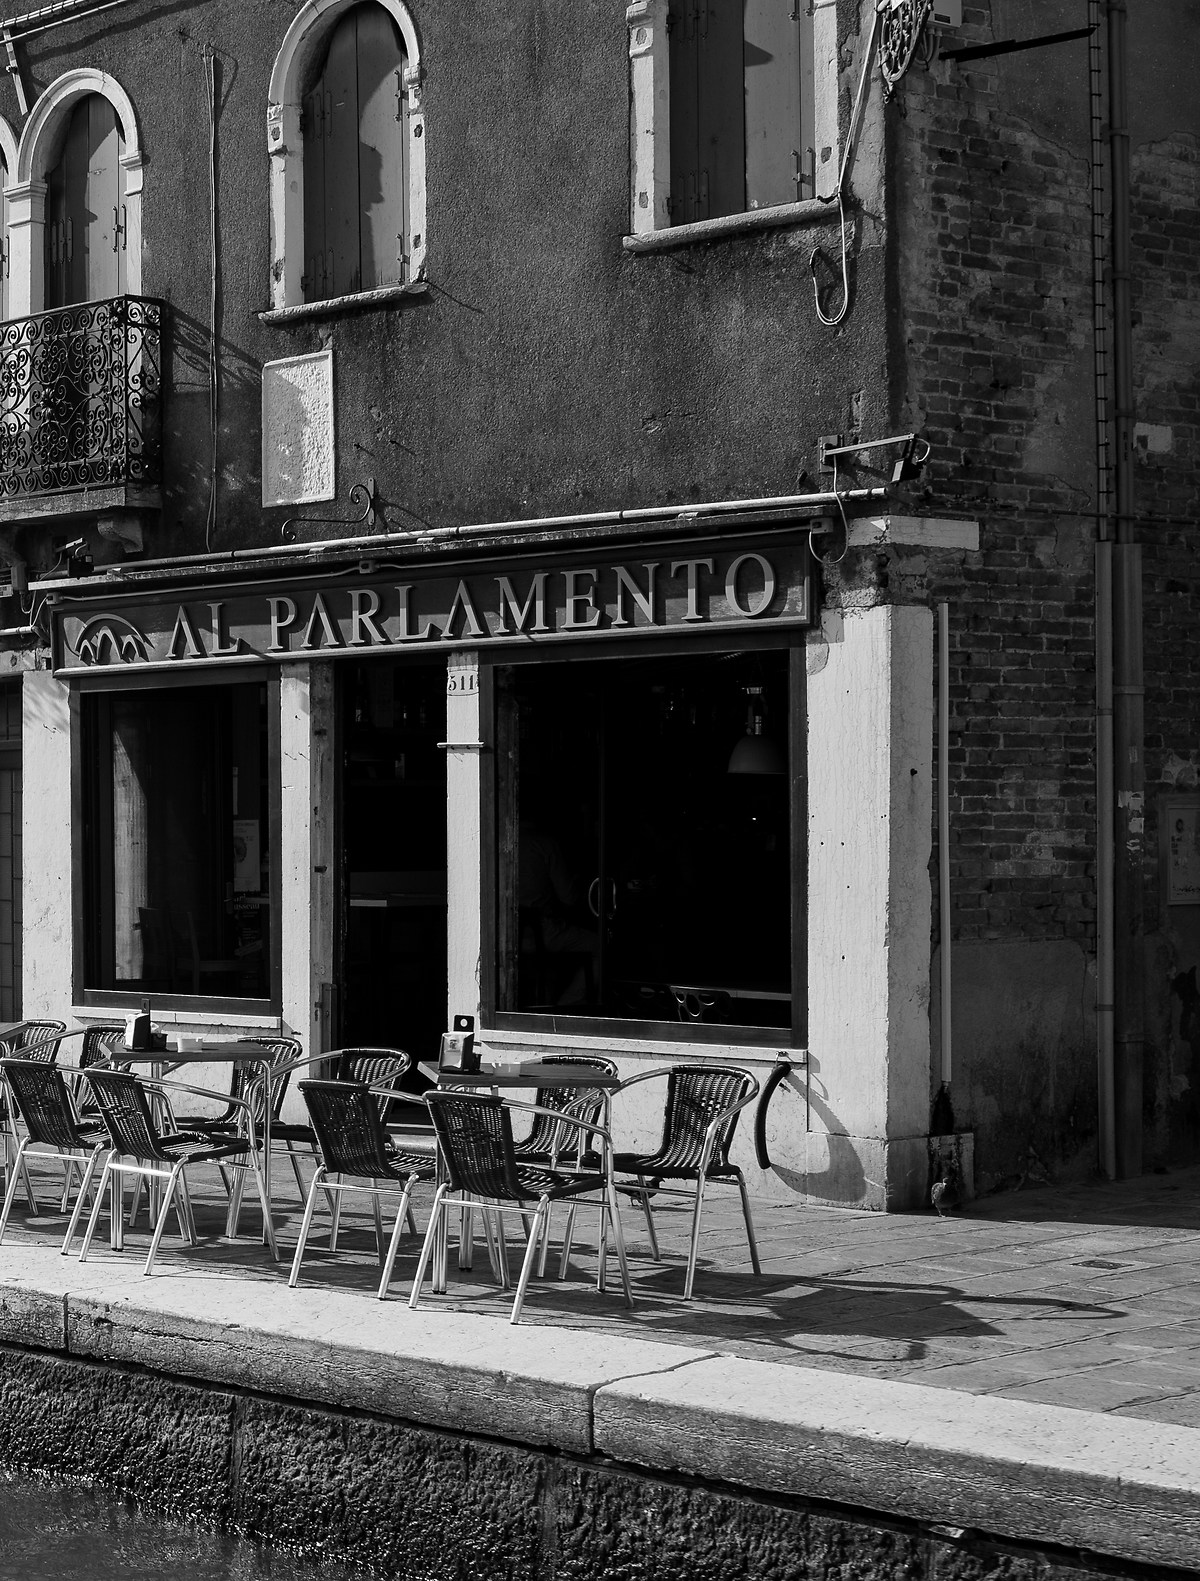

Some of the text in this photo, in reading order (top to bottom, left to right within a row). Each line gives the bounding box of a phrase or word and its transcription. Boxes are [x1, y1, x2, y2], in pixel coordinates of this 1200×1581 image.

[165, 553, 775, 658] AL PARLAMENTO
[448, 674, 474, 691] 511
